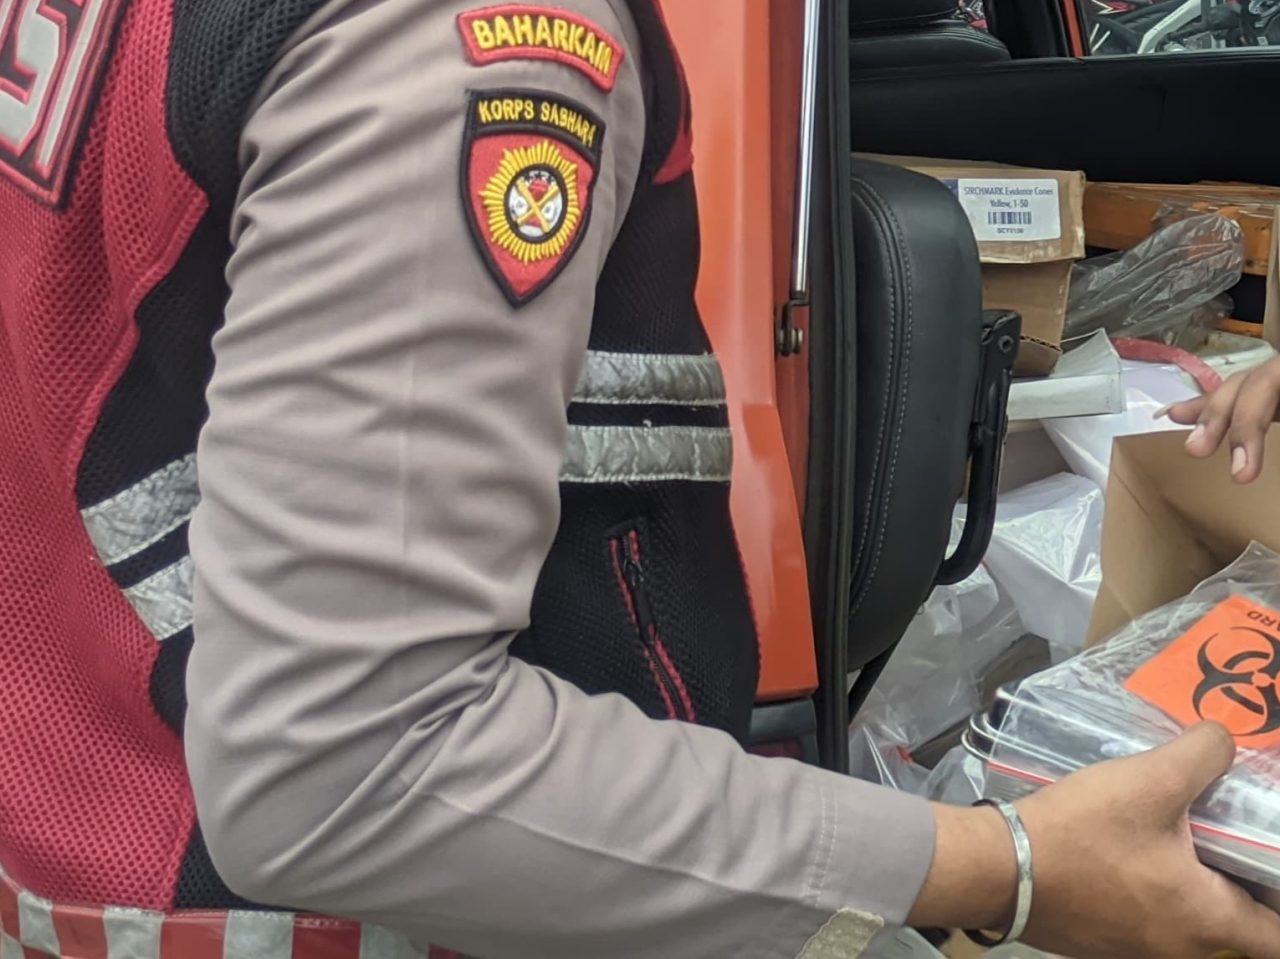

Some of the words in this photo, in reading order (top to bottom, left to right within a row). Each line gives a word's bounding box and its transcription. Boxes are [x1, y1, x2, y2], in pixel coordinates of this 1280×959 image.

[472, 14, 613, 75] BAHARKAM
[478, 98, 534, 124] KORPS
[540, 101, 597, 147] SABHARA
[1004, 186, 1033, 196] Evidence
[1034, 186, 1054, 196] Cones
